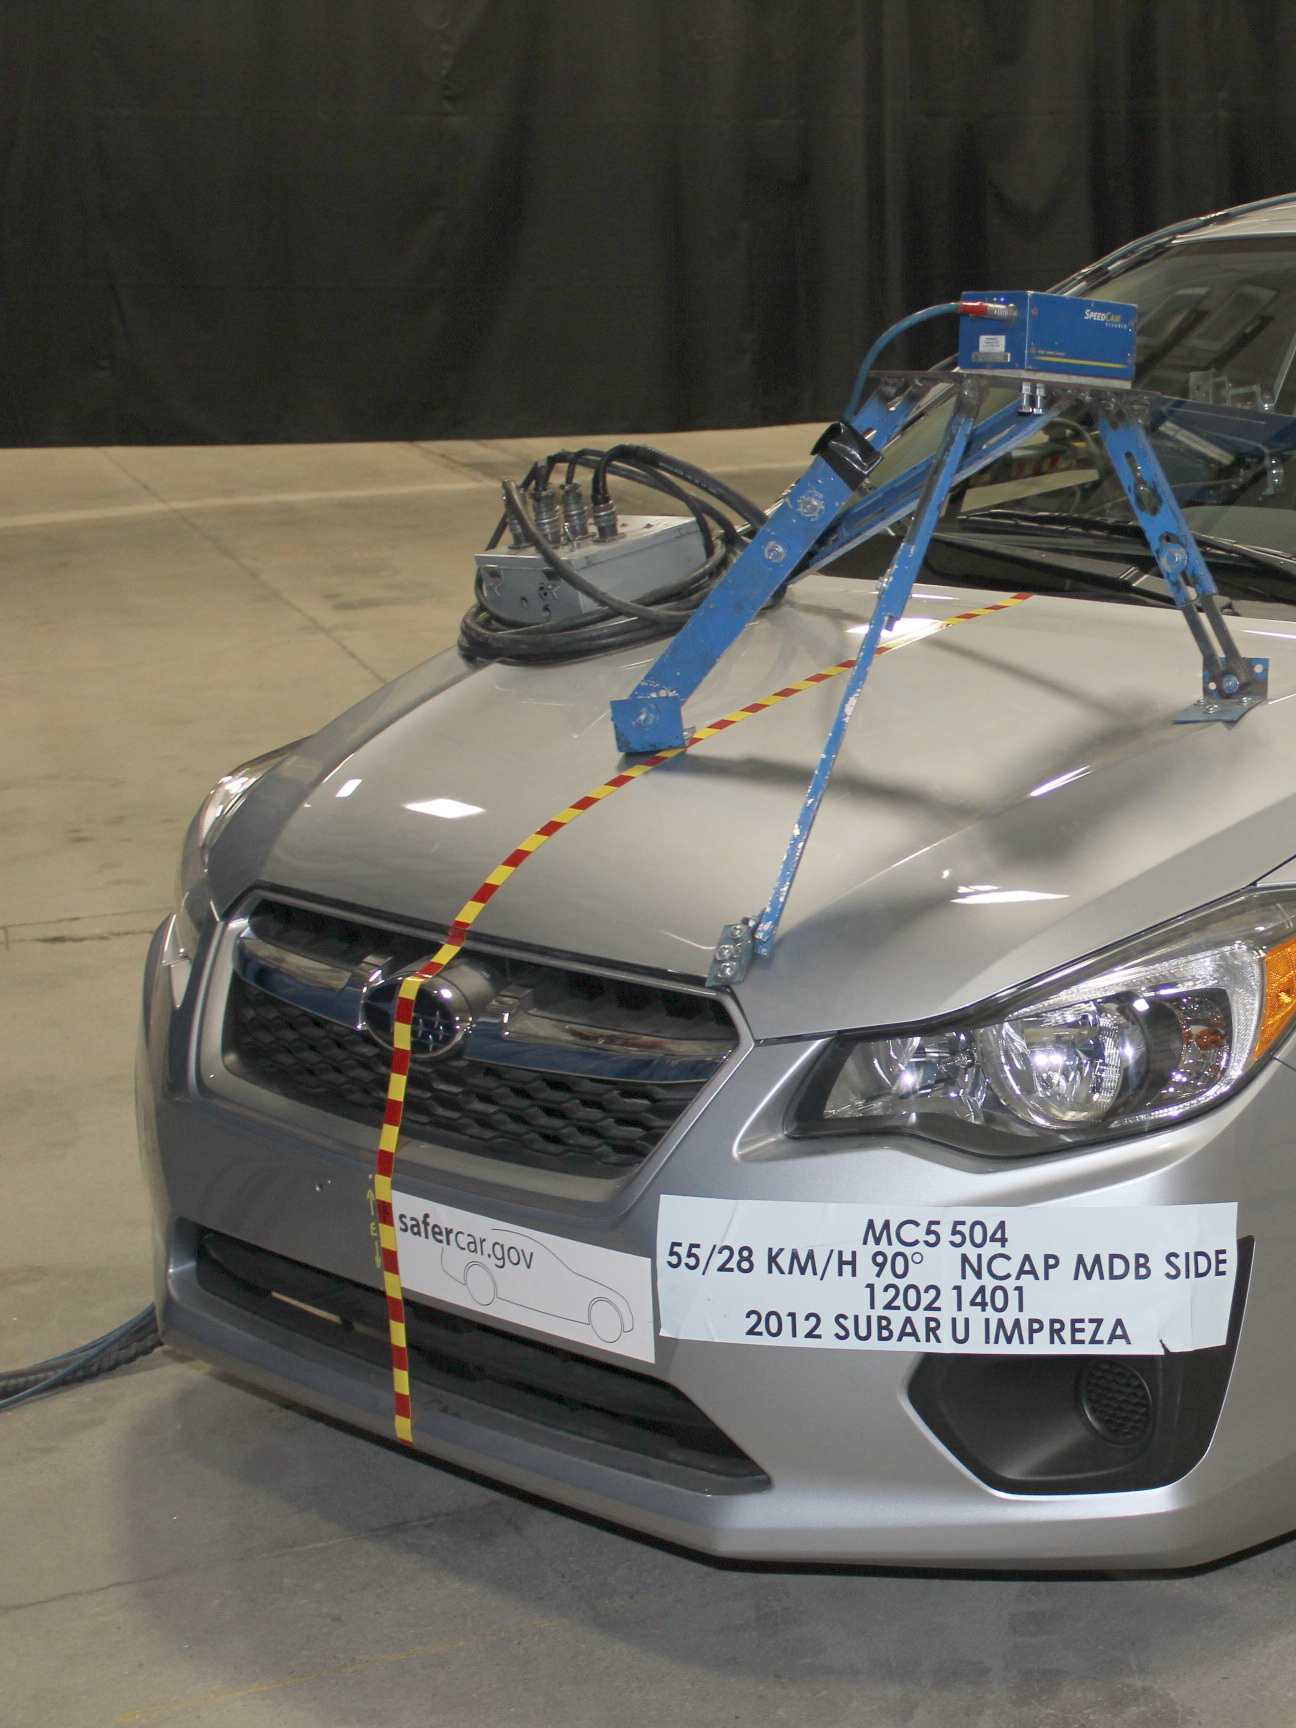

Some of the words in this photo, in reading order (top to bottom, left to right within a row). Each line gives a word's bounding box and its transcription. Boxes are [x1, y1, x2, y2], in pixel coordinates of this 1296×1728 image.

[398, 1212, 534, 1270] safercar.gov
[666, 1241, 755, 1278] 55/28
[766, 1247, 858, 1281] KM/H
[870, 1251, 924, 1280] 90°
[960, 1252, 1061, 1282] NCAP
[1072, 1252, 1153, 1282] MDB
[1164, 1248, 1229, 1281] SIDE
[744, 1309, 823, 1340] 2012
[833, 1313, 972, 1345] SUBARU
[982, 1317, 1132, 1346] IMPREZA
